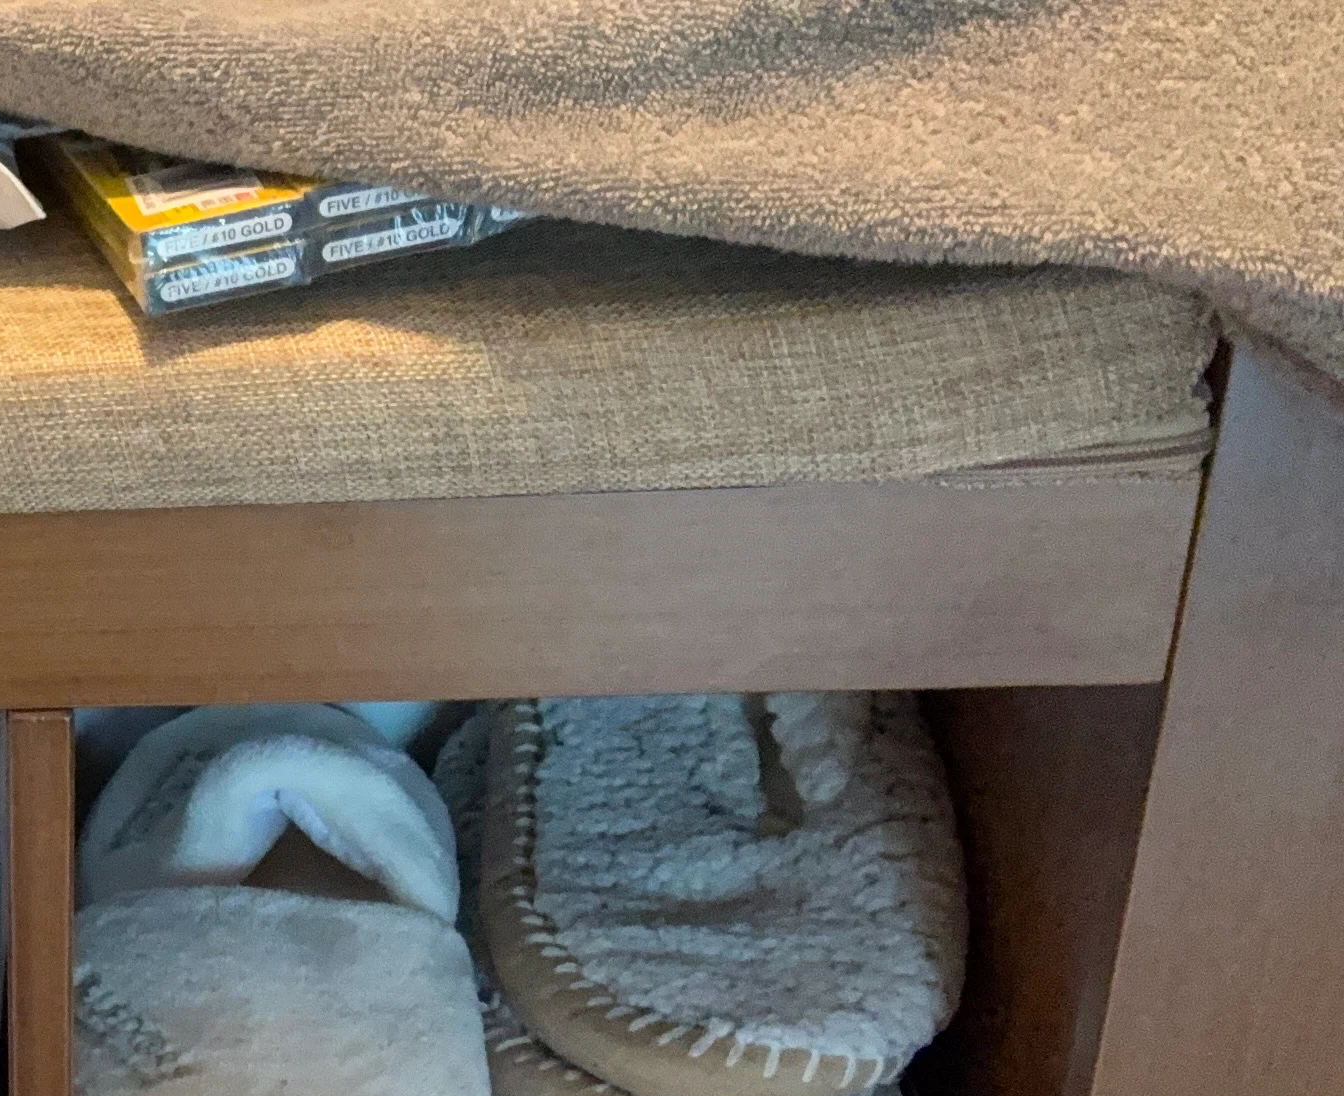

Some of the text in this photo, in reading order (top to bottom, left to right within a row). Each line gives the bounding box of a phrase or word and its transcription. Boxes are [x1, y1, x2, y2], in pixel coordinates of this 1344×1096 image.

[326, 195, 361, 214] FIVE
[374, 190, 400, 205] #10
[211, 227, 237, 243] #10
[240, 217, 285, 238] GOLD
[329, 241, 363, 258] FIVE
[406, 224, 451, 243] GOLD
[167, 281, 202, 299] FIVE
[242, 262, 288, 282] GOLD
